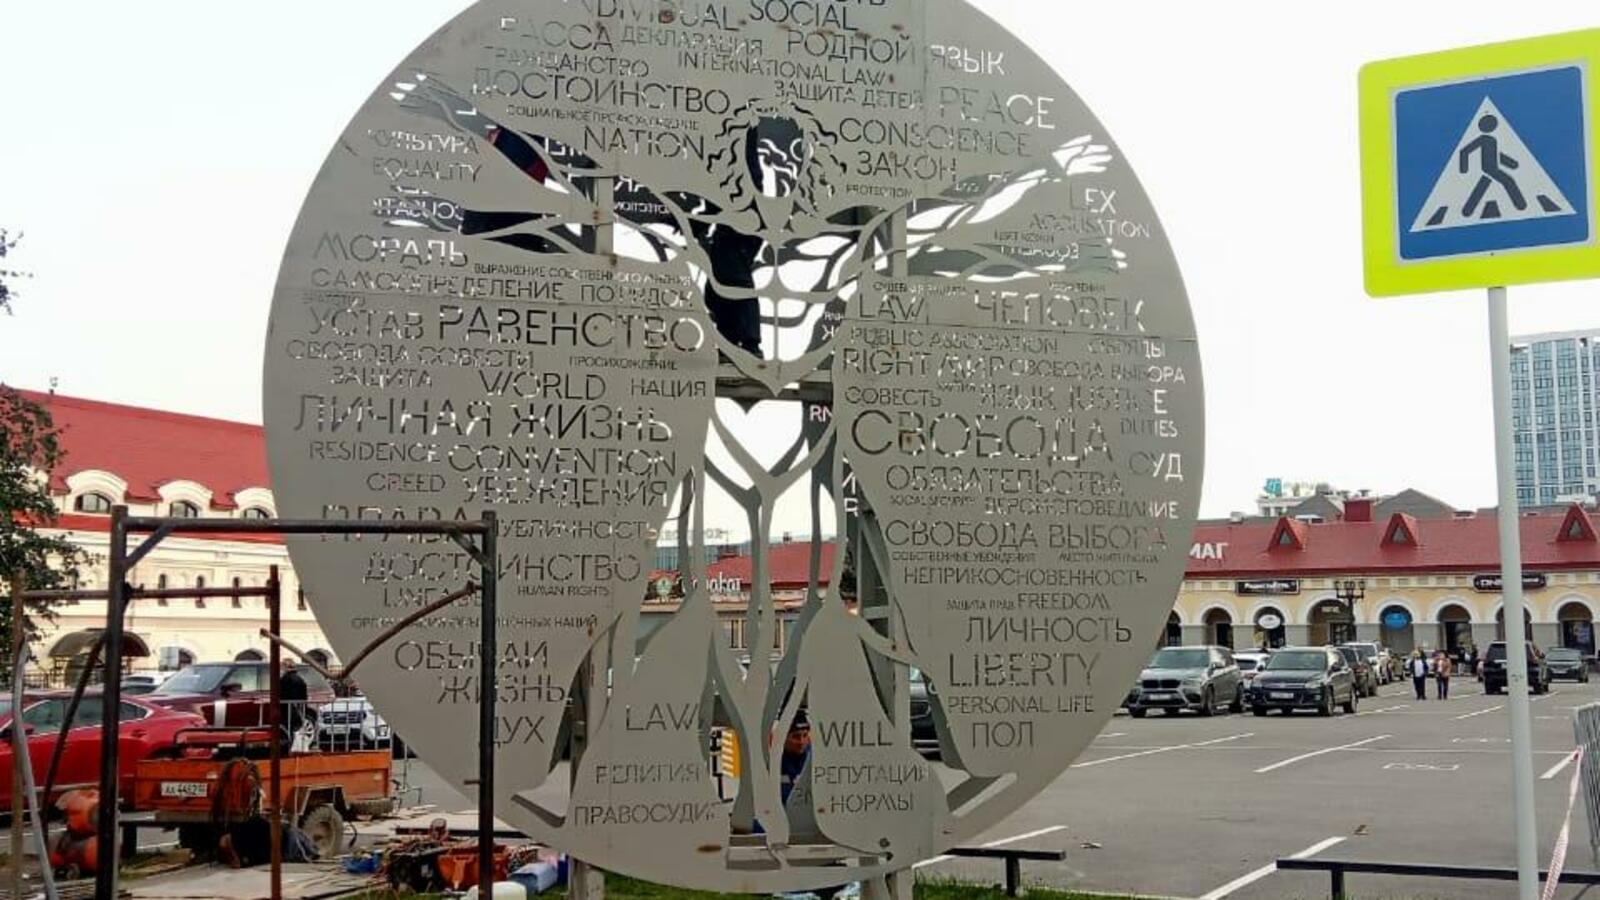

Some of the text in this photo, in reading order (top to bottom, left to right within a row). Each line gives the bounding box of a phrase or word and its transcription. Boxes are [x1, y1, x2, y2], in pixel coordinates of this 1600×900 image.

[749, 0, 859, 32] SOCIAL
[787, 30, 916, 64] РОДНОЙ
[471, 67, 731, 115] ДОСТОИНСТВО
[842, 67, 886, 86] LAW
[939, 86, 1056, 130] PEACE
[584, 125, 705, 161] NATION
[838, 117, 1033, 158] CONSCIENCE
[372, 157, 482, 183] EQUALITY
[856, 150, 957, 182] ЗАКОН
[1068, 181, 1117, 215] LEX
[312, 233, 469, 267] МОРАЛЬ
[309, 303, 425, 340] УСТАВ
[858, 293, 926, 321] LAW
[974, 289, 1147, 333] ЧЕЛОВЕК
[439, 304, 705, 351] РАВЕНСТВО
[842, 346, 933, 376] RIGHT
[479, 370, 607, 400] WORLD
[630, 377, 706, 400] НАЦИЯ
[844, 385, 942, 408] СОВЕСТЬ
[293, 394, 674, 443] ЛИЧНАЯ ЖИЗНЬ
[851, 409, 1114, 468] СВОБОДА
[309, 441, 677, 478] RESIDENCE CONVENTION
[1128, 450, 1184, 483] СУД
[366, 472, 446, 493] CREED
[494, 518, 658, 541] УБЛИЧНОСТЬ
[884, 519, 1038, 552] СВОБОДА
[517, 584, 565, 597] HUMAN
[903, 566, 1148, 587] НЕПРИКОСНОВЕННОСТЬ
[1017, 592, 1111, 610] FREEDOM
[965, 616, 1133, 643] ЛИЧНОСТЬ
[394, 640, 549, 671] ОБЫАИ
[949, 652, 1102, 688] LIBERTY
[437, 674, 567, 704] ЖЗНЬ
[948, 694, 1095, 714] PERSONAL LIFE
[625, 702, 701, 732] LAW
[818, 721, 894, 748] WILL
[972, 721, 1034, 748] ПОЛ
[829, 793, 914, 813] НОРМЫ
